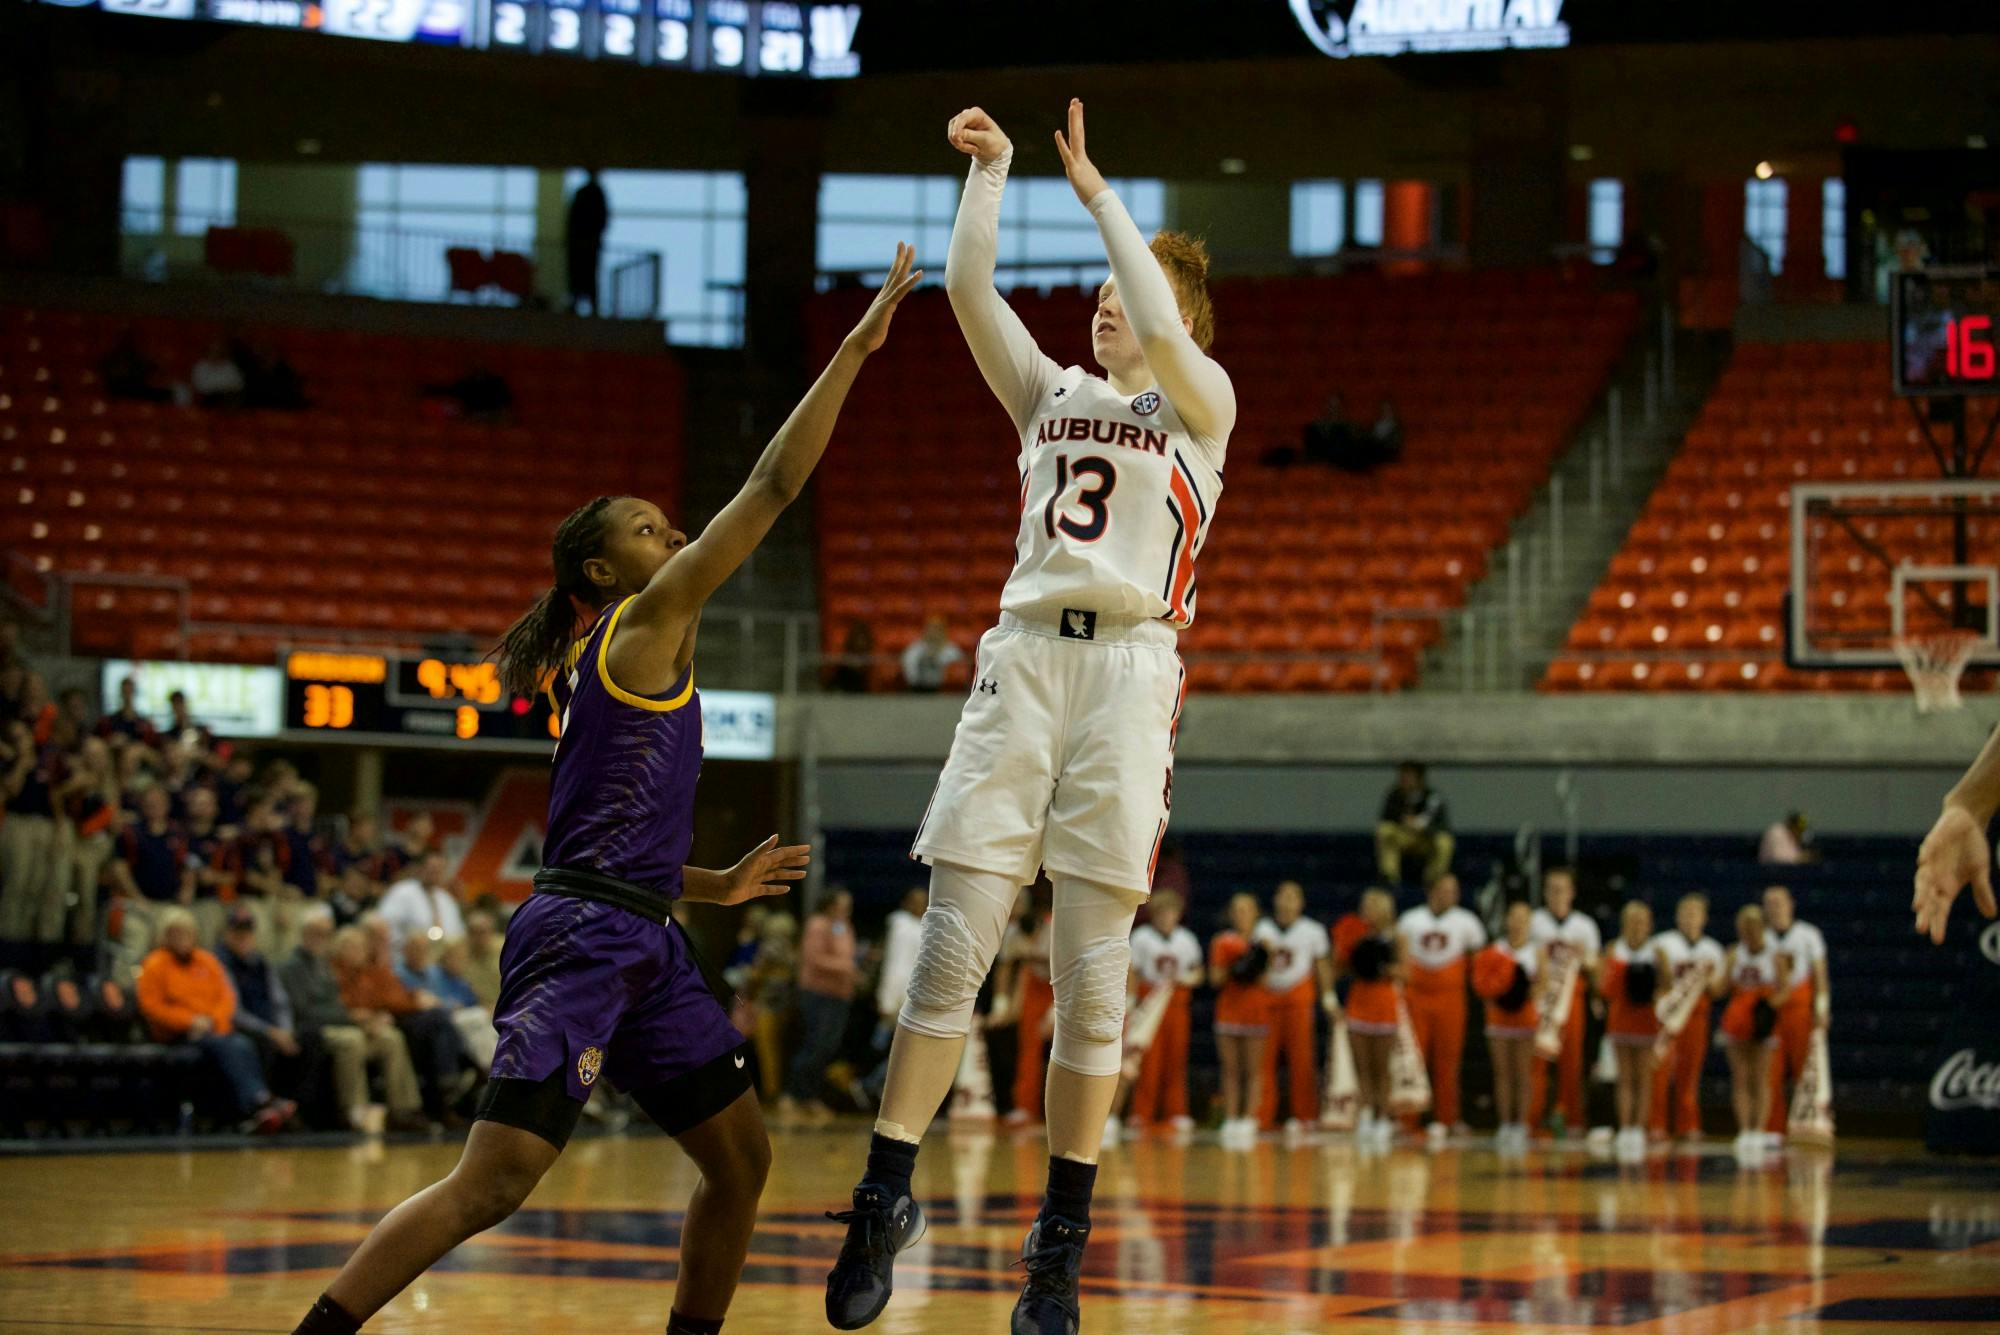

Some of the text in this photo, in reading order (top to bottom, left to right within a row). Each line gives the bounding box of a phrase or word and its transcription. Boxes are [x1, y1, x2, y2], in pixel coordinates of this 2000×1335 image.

[1946, 315, 1995, 379] 16
[1133, 394, 1160, 415] SEC
[1036, 417, 1169, 457] AUBURN
[1045, 454, 1116, 542] 13
